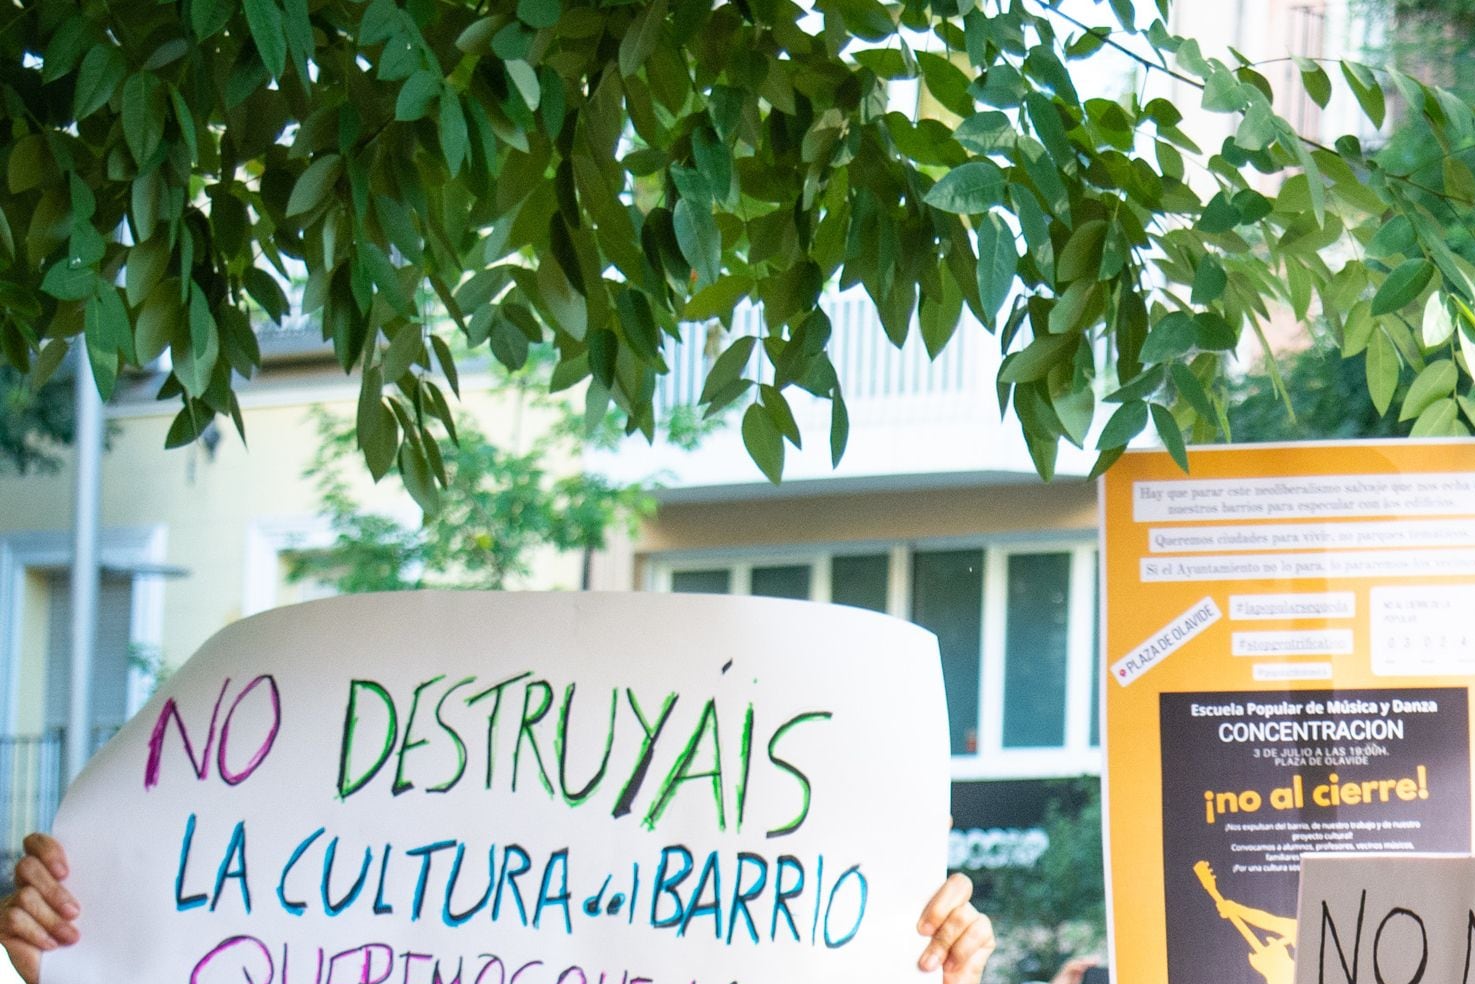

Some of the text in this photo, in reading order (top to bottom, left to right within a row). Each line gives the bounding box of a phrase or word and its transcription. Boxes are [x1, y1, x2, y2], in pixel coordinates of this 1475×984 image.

[1126, 604, 1215, 674] PLAZA DE OLAVIDE
[1191, 699, 1439, 718] Escuela Popular de Música y Danza
[1218, 719, 1405, 743] CONCENTRACION
[143, 658, 836, 840] NO DESTRUYÁIS
[1253, 748, 1261, 758] 3
[1263, 748, 1278, 758] DE
[1280, 747, 1313, 758] JULIO
[1314, 747, 1323, 757] A
[1325, 746, 1346, 757] LAS
[1274, 756, 1369, 767] PLAZA DE OLAVIDE
[1203, 765, 1430, 823] ¡no al cierre!
[1292, 832, 1324, 842] proyecto
[1263, 863, 1288, 873] cultura
[173, 812, 255, 919] LA
[277, 826, 573, 935] CULTURA
[650, 843, 870, 949] BARRIO
